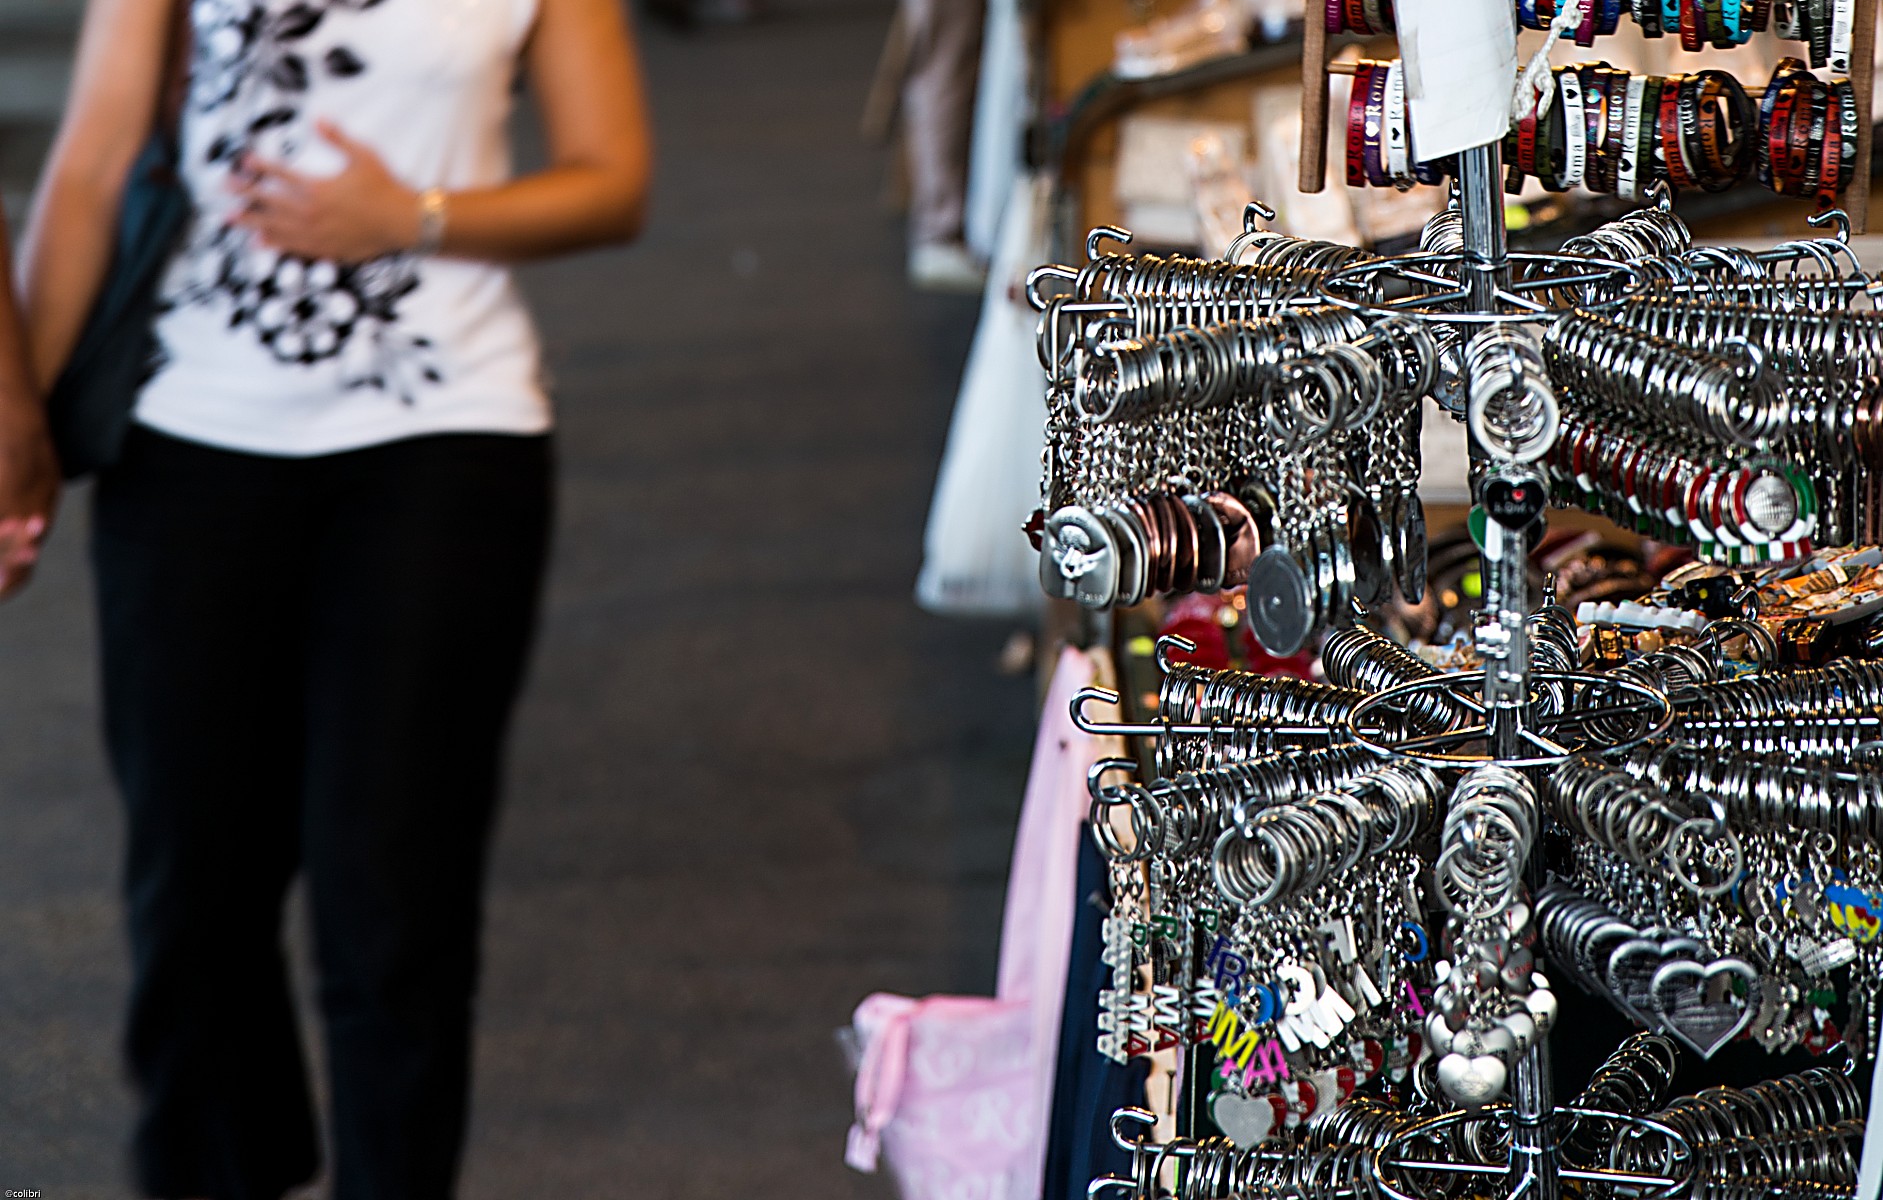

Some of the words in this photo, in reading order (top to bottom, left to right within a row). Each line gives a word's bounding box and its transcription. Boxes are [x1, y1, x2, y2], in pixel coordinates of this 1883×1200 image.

[1623, 106, 1639, 154] Roma
[1680, 88, 1695, 134] Roma
[1568, 144, 1584, 187] Roma
[1822, 140, 1839, 188] Roma
